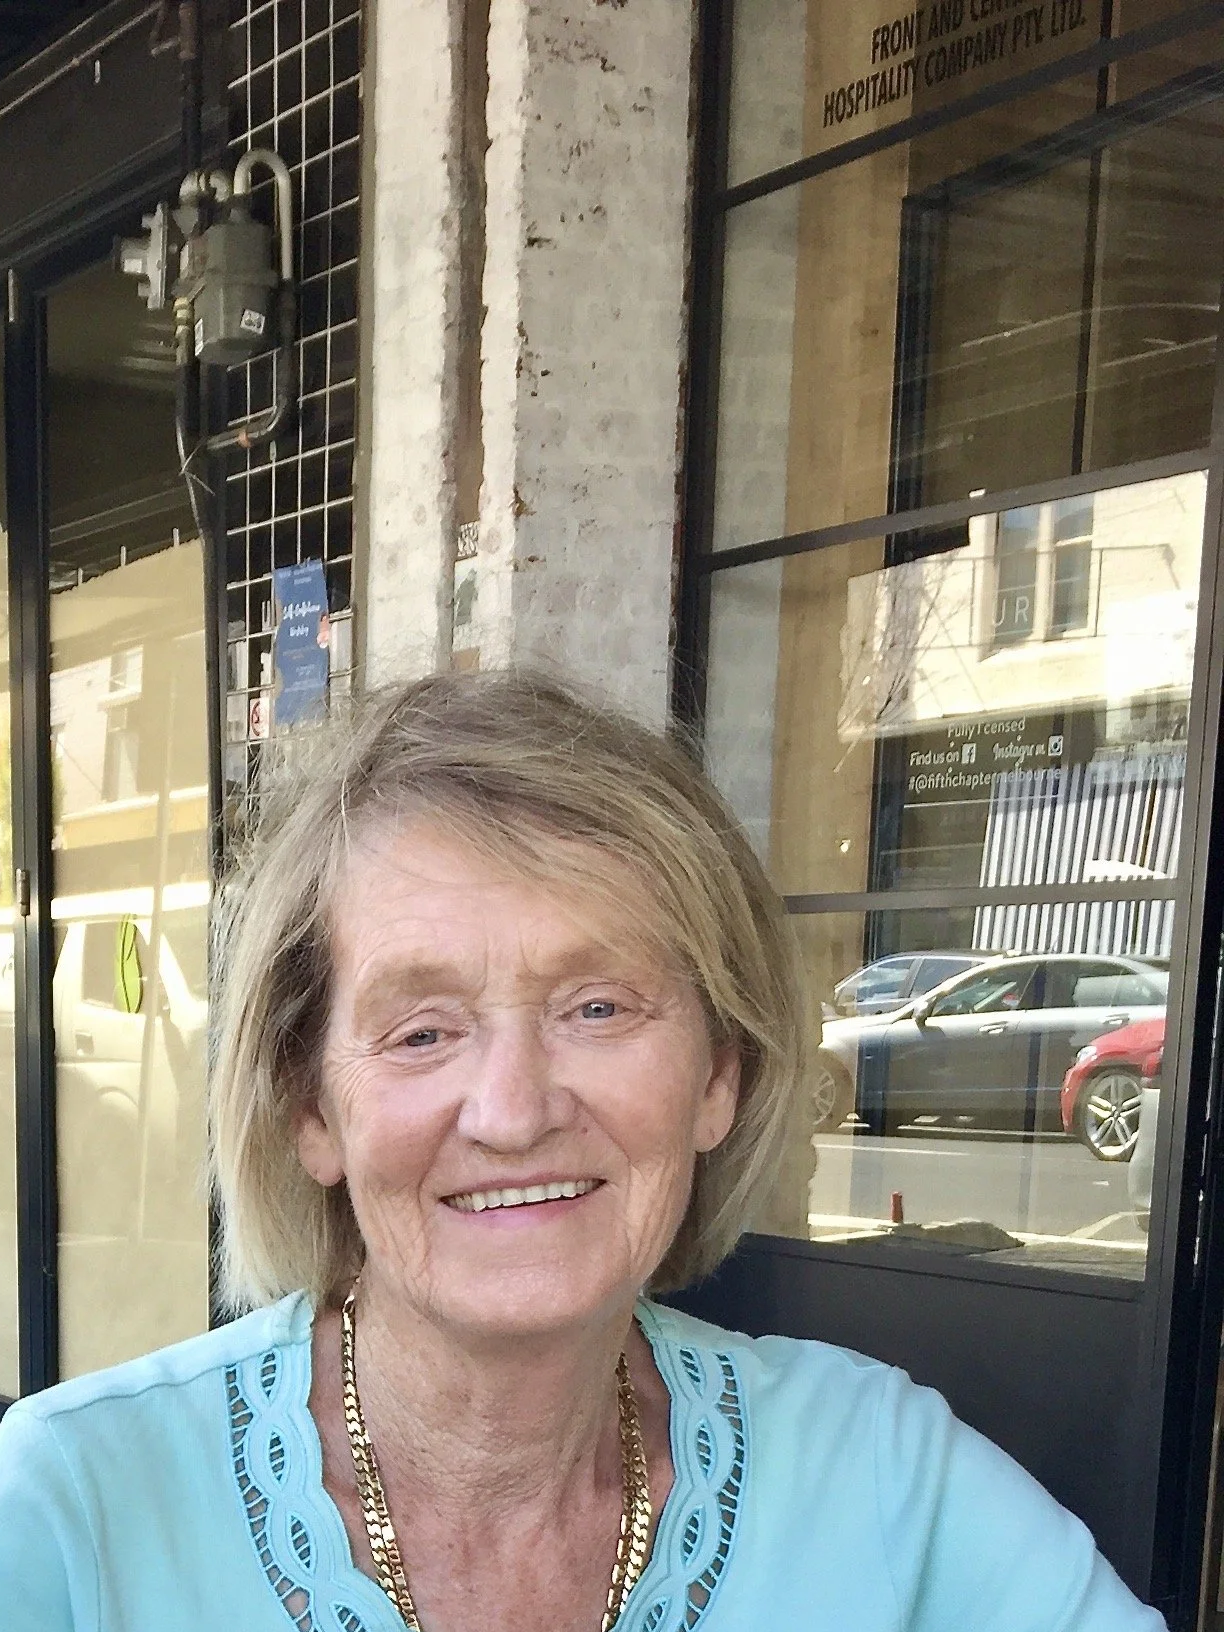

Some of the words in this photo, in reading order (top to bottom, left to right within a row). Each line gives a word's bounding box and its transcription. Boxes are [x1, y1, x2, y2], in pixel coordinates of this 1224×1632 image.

[871, 8, 923, 65] FRONT
[927, 0, 963, 42] AND
[823, 56, 920, 128] HOSPITALITY
[925, 20, 1007, 88] COMPANY
[948, 723, 975, 740] Fully
[946, 750, 959, 763] on
